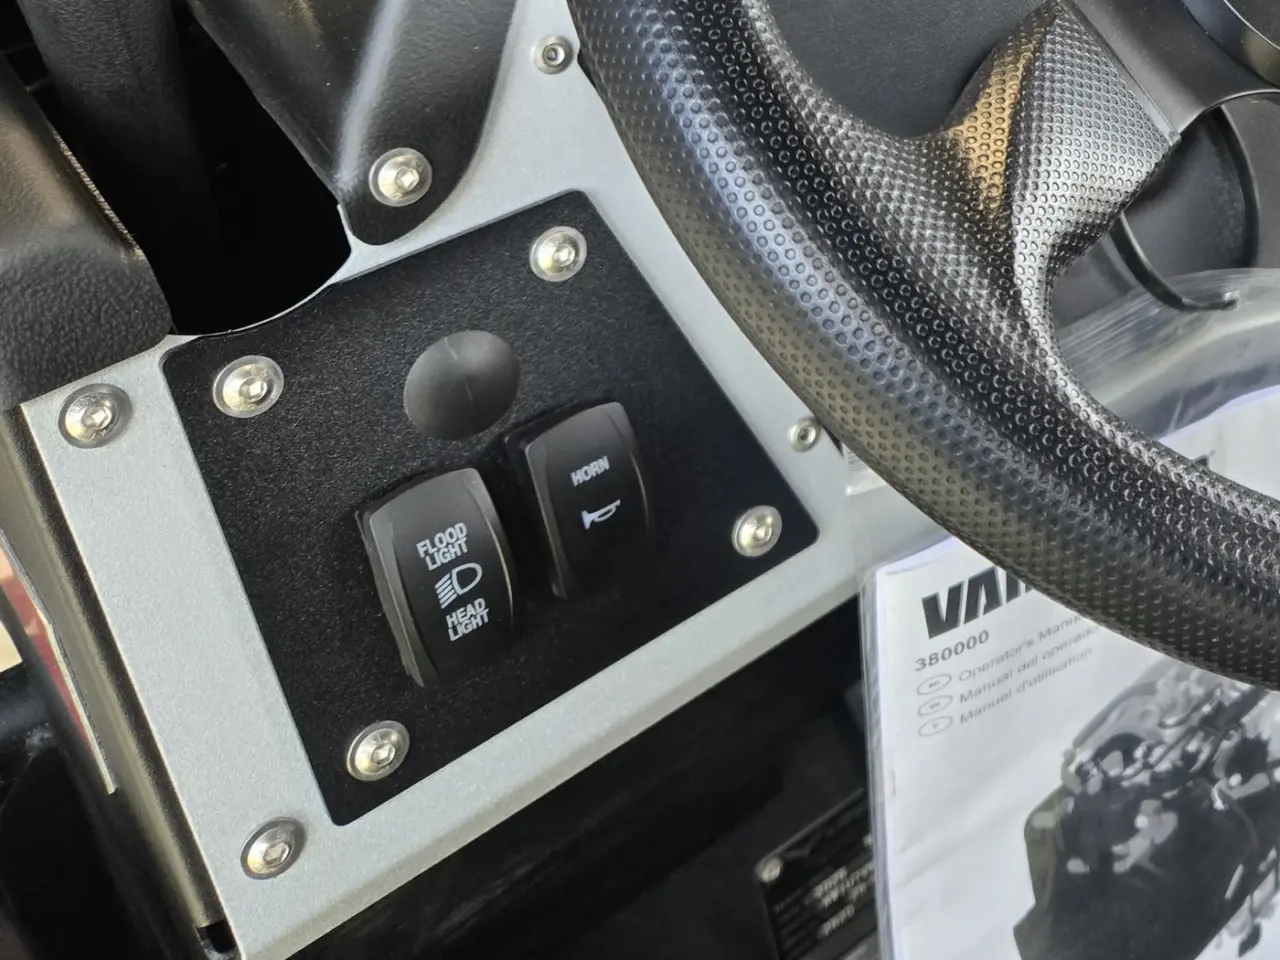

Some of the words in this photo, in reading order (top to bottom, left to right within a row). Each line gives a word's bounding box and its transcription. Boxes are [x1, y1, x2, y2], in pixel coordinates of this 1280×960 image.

[570, 456, 610, 487] HORN
[416, 522, 468, 558] FLOOD
[424, 537, 469, 571] LIGHT
[445, 597, 486, 628] HEAD
[448, 608, 489, 641] LIGHT
[913, 629, 990, 672] 380000
[958, 637, 1034, 682] Operator's
[960, 671, 1013, 704] Manual
[1042, 625, 1100, 660] operado
